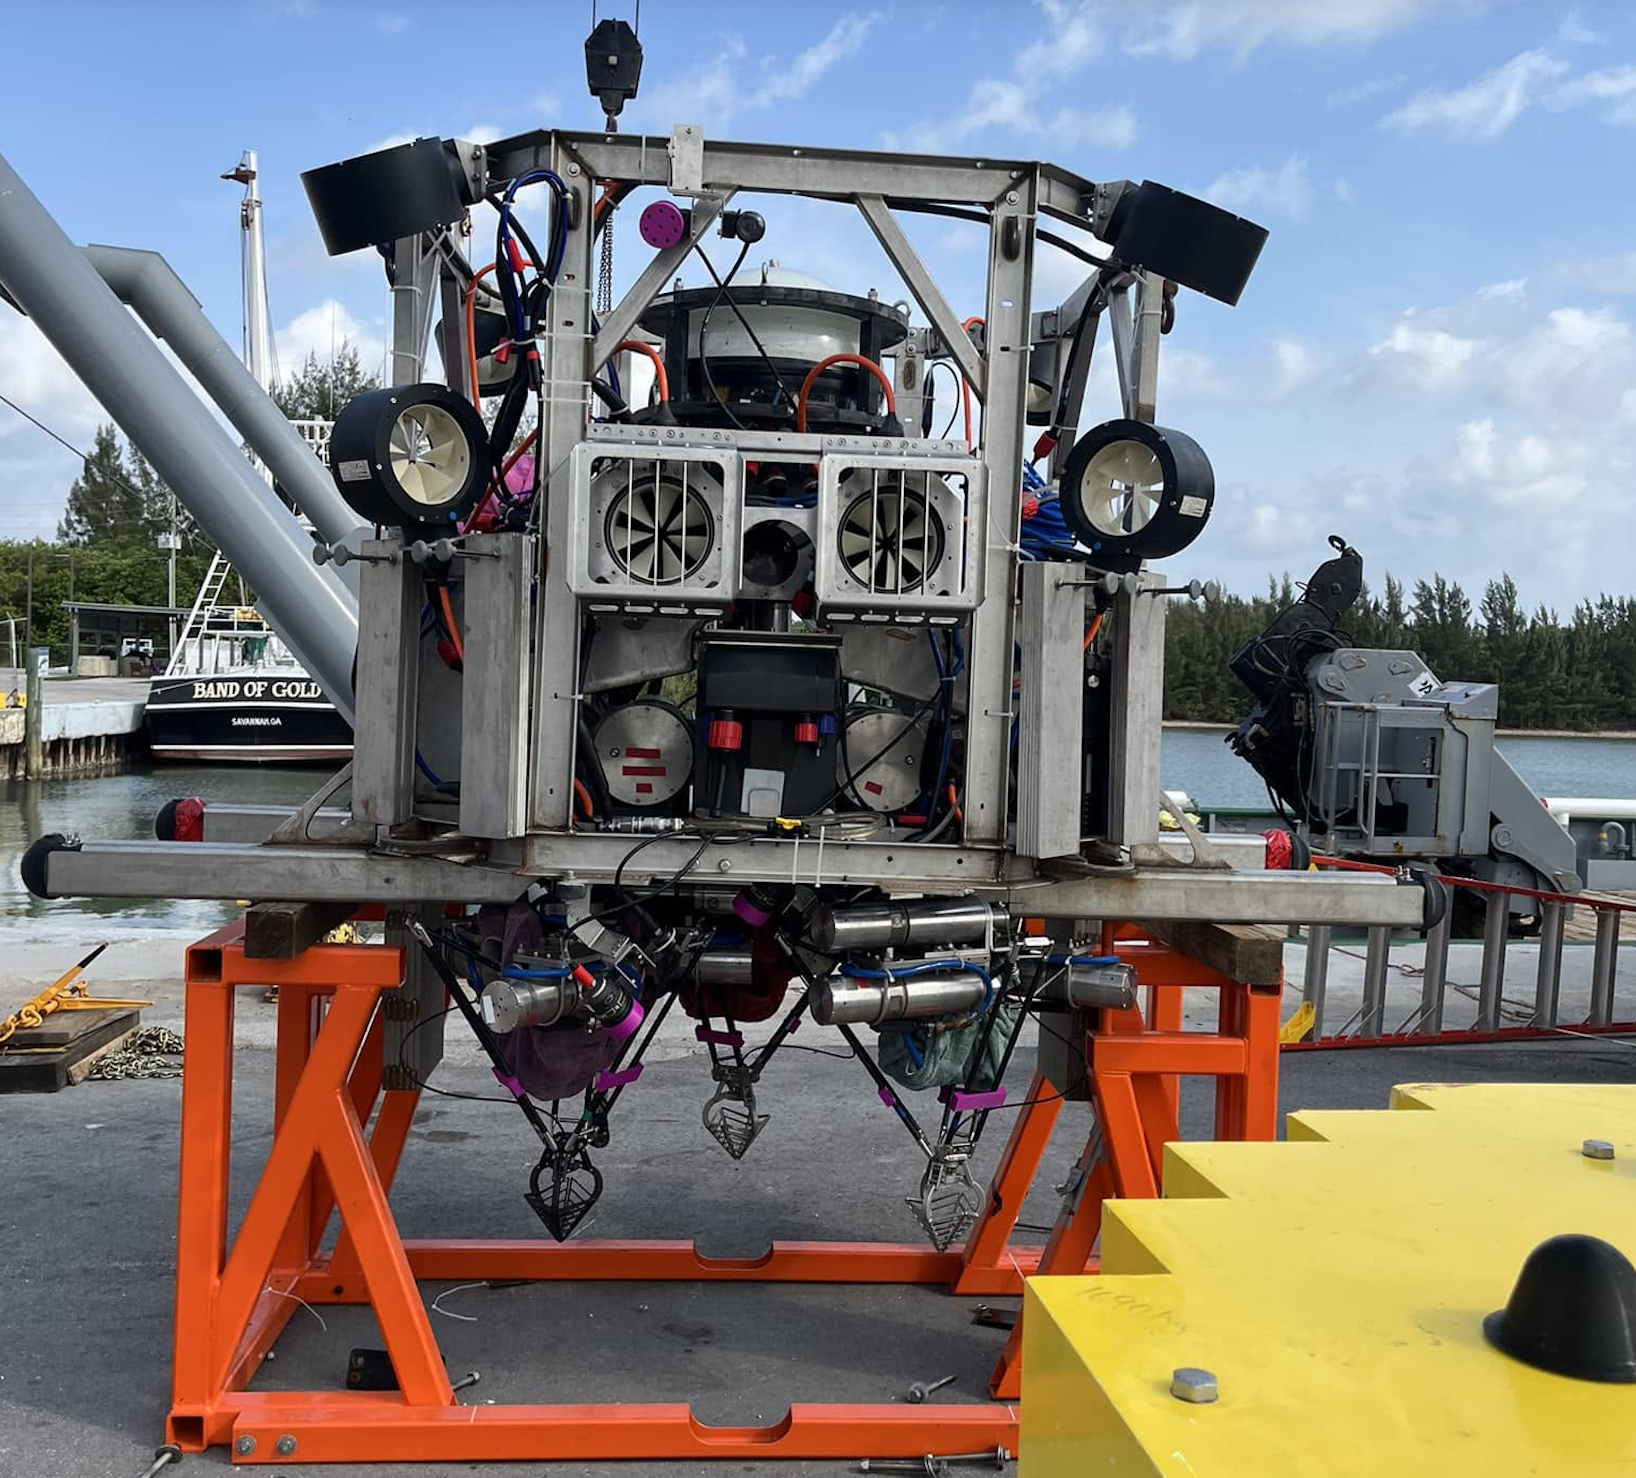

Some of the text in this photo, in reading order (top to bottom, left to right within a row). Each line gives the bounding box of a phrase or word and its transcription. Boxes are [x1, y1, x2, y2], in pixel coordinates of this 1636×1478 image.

[193, 681, 322, 699] BAND OF GOLD
